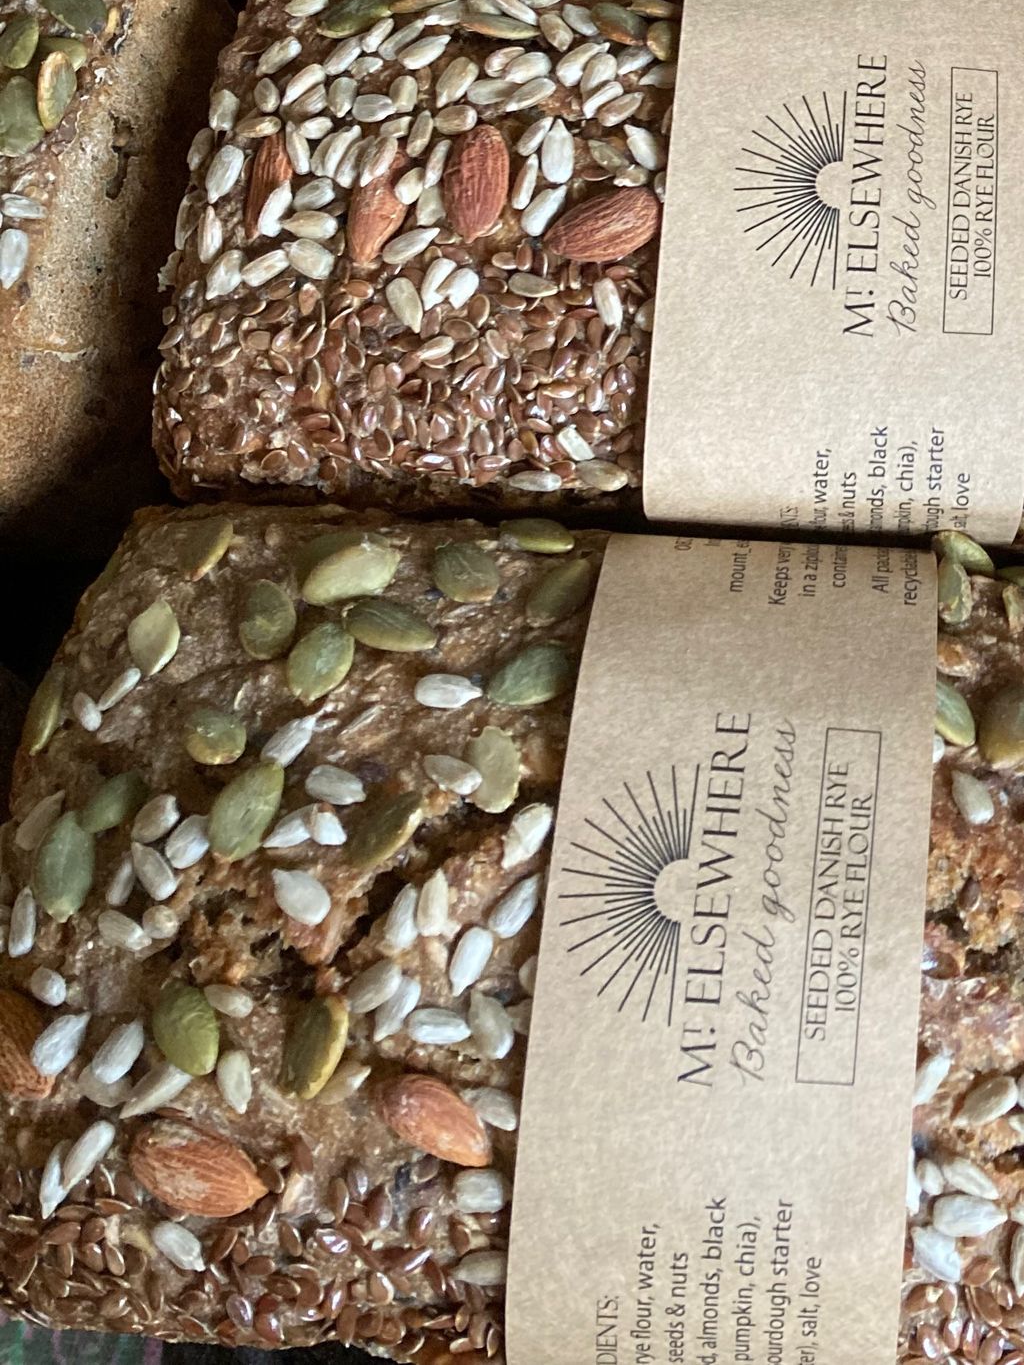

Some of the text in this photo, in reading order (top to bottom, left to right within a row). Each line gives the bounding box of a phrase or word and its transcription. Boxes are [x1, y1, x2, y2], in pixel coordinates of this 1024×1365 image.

[846, 54, 887, 273] ELSEWHERE
[886, 60, 937, 336] Baked goodness
[950, 92, 973, 300] SEEDED DANISH RYE
[973, 114, 995, 278] 100% RYE FLOUR
[813, 448, 832, 504] water,
[841, 472, 856, 509] nuts
[868, 426, 888, 477] black
[896, 440, 918, 491] chia),
[927, 427, 944, 490] starter
[951, 473, 970, 511] love
[768, 566, 794, 605] Keeps
[799, 584, 816, 597] in
[872, 576, 889, 593] All
[685, 711, 752, 1006] ELSEWHERE
[728, 717, 796, 1085] Baked goodness
[804, 761, 849, 1042] SEEDED DANISH RYE
[835, 793, 873, 1012] 100% RYE FLOUR
[700, 1196, 726, 1260] black
[771, 1198, 793, 1276] starter
[630, 1223, 661, 1364] rye flour, water,
[664, 1252, 688, 1363] seeds & nuts
[697, 1268, 723, 1349] almonds,
[732, 1216, 761, 1361] pumpkin, chia),
[798, 1257, 822, 1338] salt, love
[596, 1295, 619, 1365] DIENTS:
